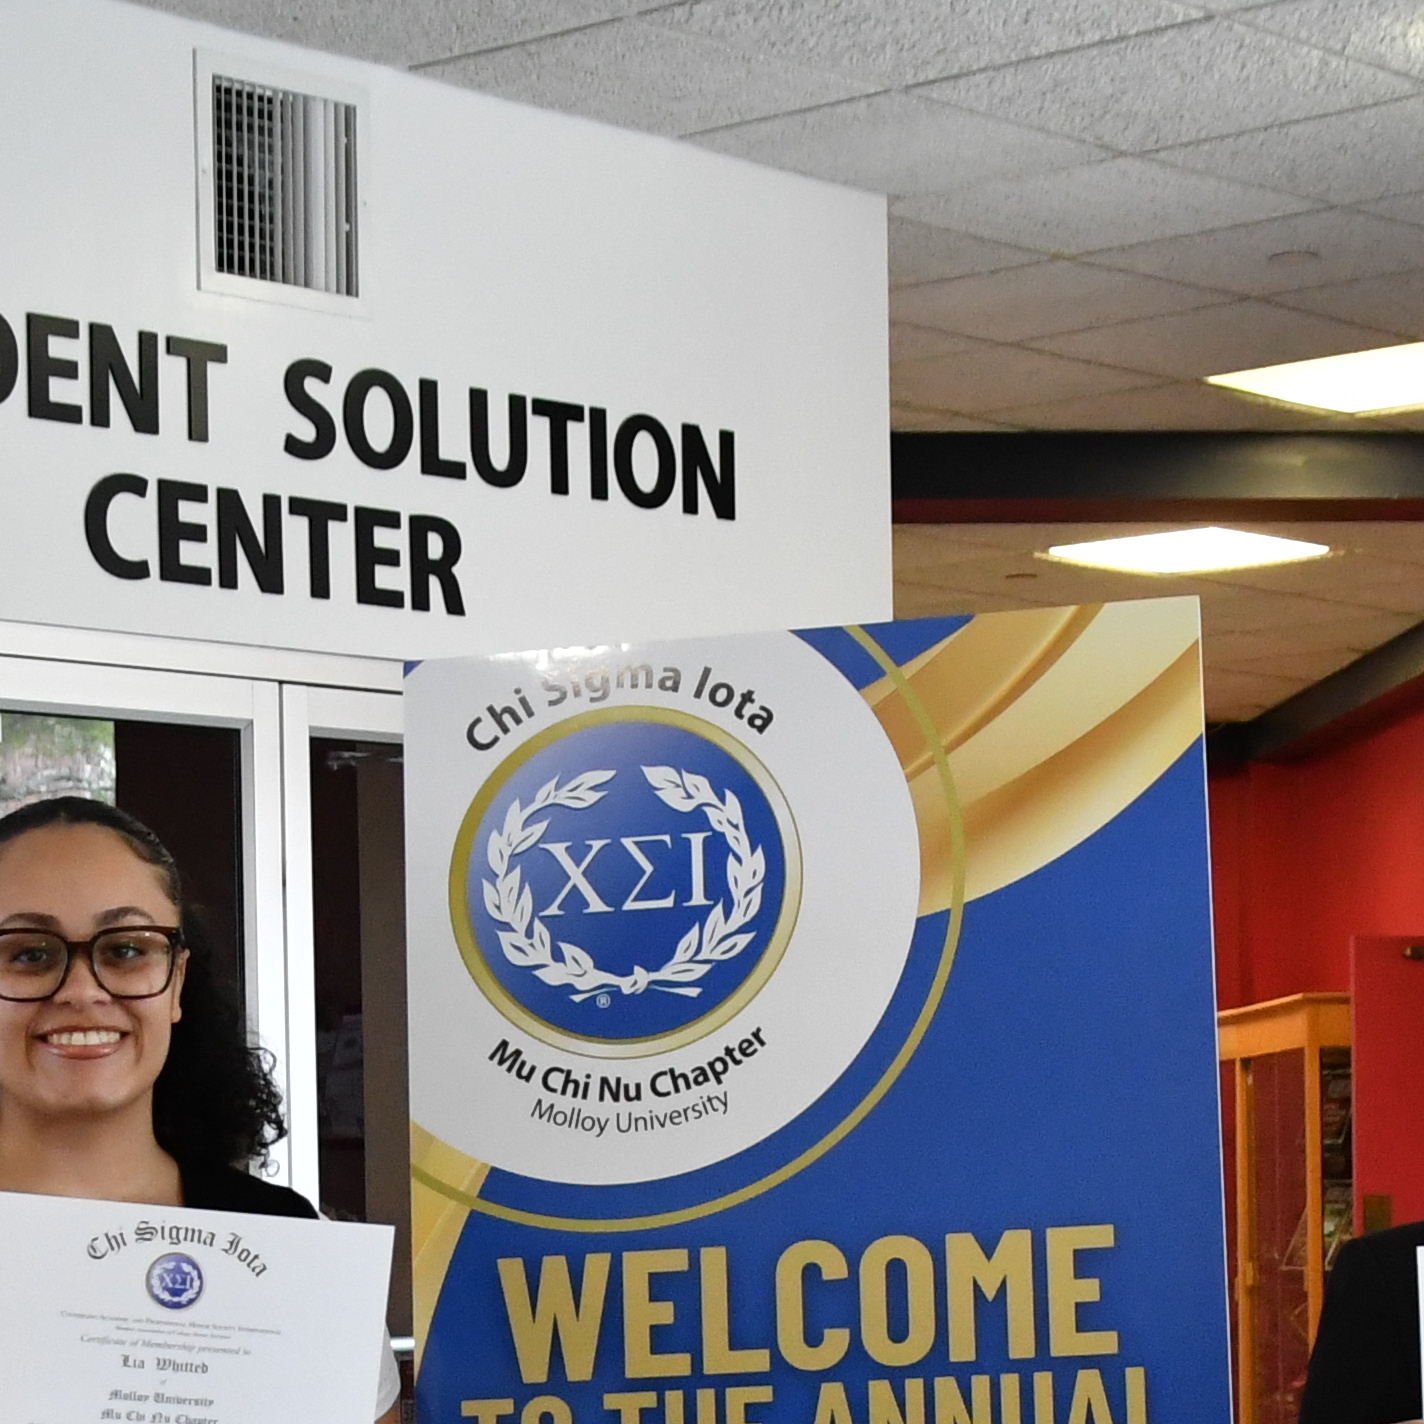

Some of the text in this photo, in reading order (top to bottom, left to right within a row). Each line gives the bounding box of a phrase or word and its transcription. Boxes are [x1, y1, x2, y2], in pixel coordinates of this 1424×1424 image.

[282, 357, 737, 522] SOLUTION
[82, 471, 467, 617] CENTER
[466, 687, 535, 751] Chi
[693, 666, 774, 735] Iota
[488, 1026, 767, 1103] Mu Chi Nu Chapter
[530, 1090, 728, 1138] Molloy University
[87, 1220, 267, 1277] Chi Sigma Iota
[496, 1224, 1119, 1385] WELCOME
[109, 1389, 214, 1406] Molloy University
[121, 1354, 209, 1375] Lia Whitted
[101, 1409, 121, 1421] Mu
[126, 1410, 145, 1422] Chi
